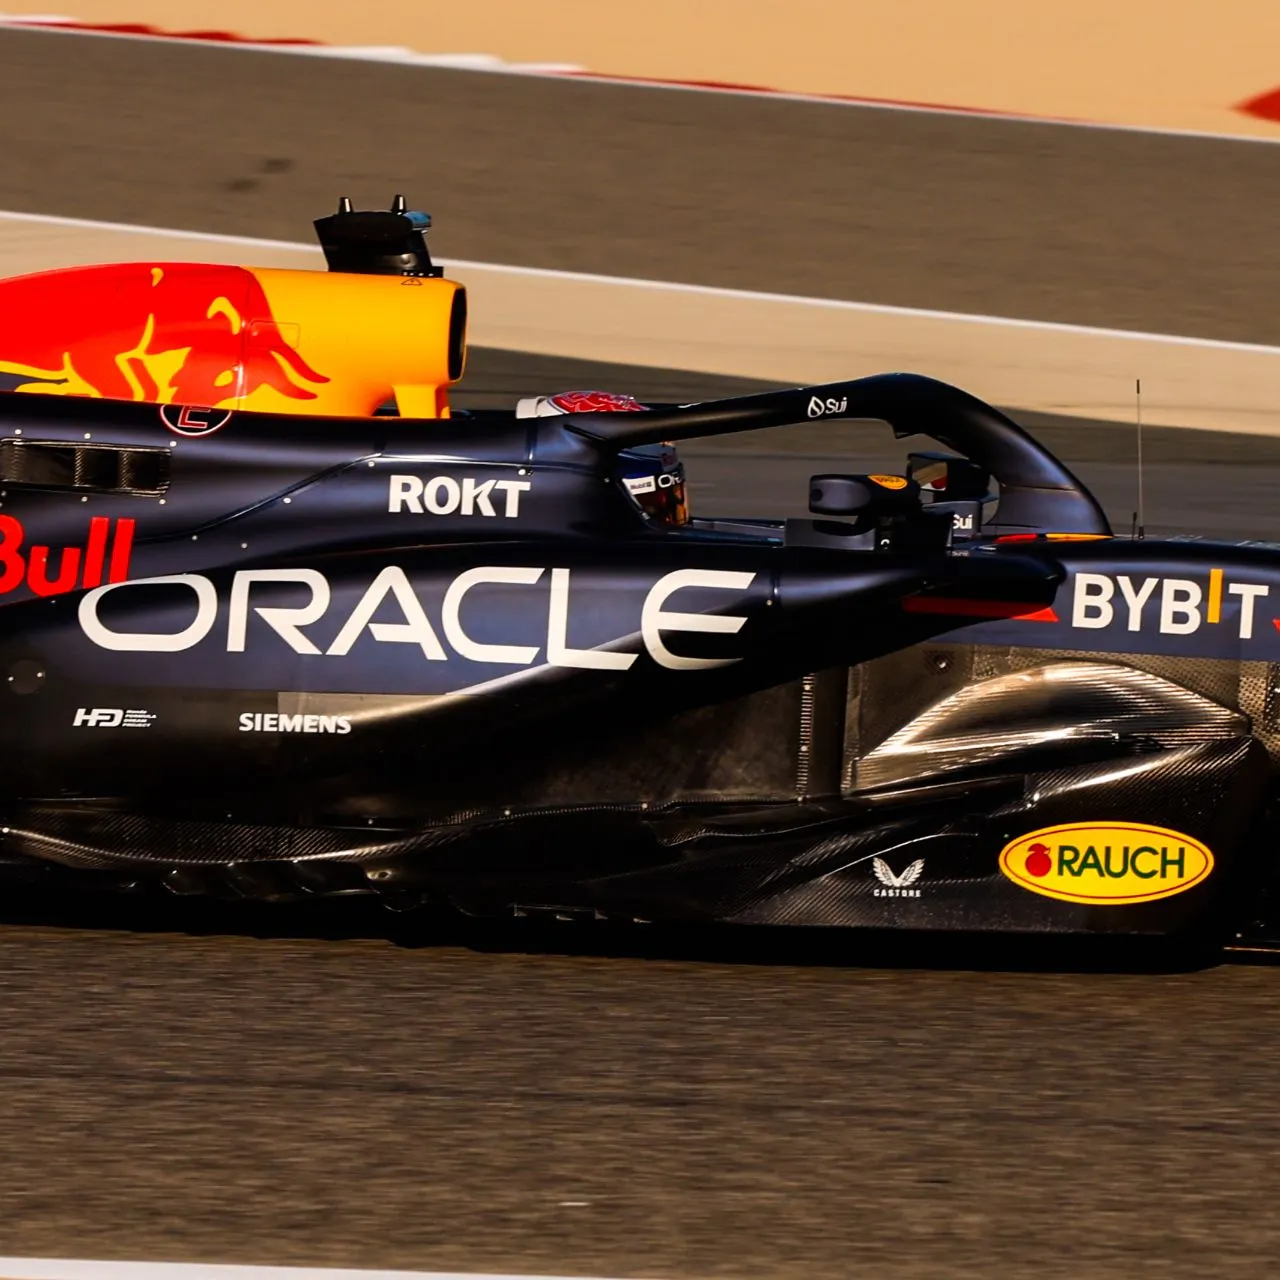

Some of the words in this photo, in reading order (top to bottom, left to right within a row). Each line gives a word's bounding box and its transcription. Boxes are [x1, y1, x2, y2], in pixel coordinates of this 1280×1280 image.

[825, 397, 848, 414] Sui
[388, 475, 531, 518] ROKT
[77, 565, 757, 672] ORACLE
[1072, 568, 1269, 640] BYBIT
[238, 712, 352, 735] SIEMENS
[1057, 845, 1186, 880] RAUCH
[873, 888, 922, 898] CASTORE
